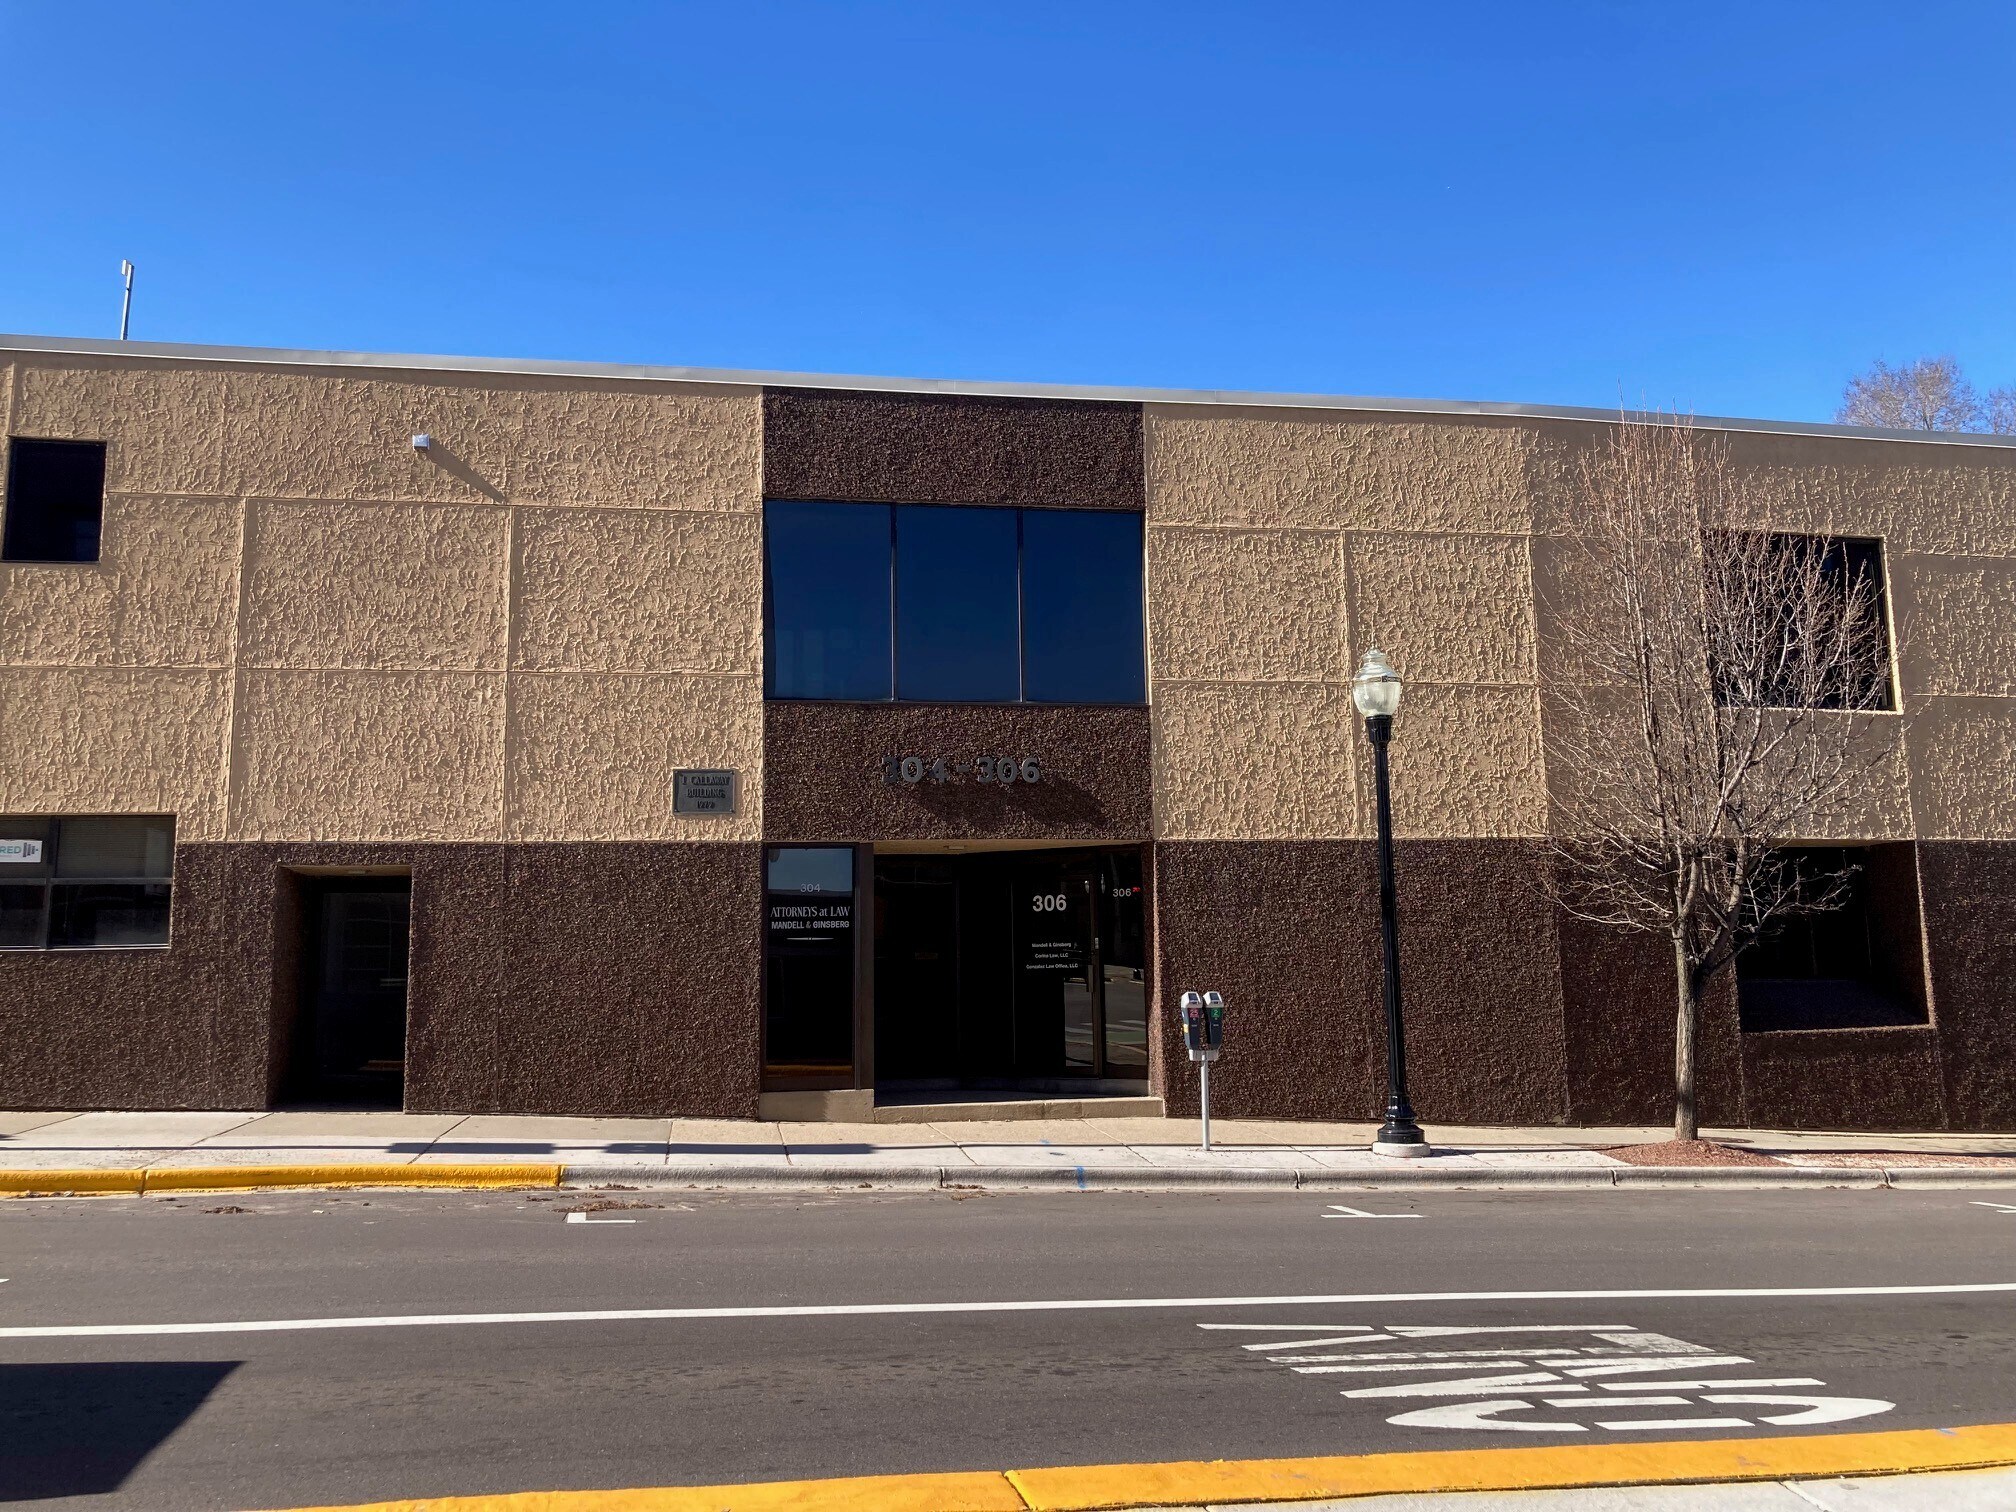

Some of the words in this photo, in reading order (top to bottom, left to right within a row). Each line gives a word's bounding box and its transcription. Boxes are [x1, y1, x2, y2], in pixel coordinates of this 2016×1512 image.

[800, 883, 821, 893] 304
[1112, 888, 1132, 897] 306
[1032, 894, 1067, 912] 306
[770, 906, 817, 918] ATTORNEYS
[819, 908, 828, 917] at
[830, 906, 850, 917] LAW
[771, 921, 804, 930] MANDELL
[805, 920, 812, 929] &
[812, 920, 850, 928] GINSBERG
[1195, 1323, 1896, 1432] ONLY
